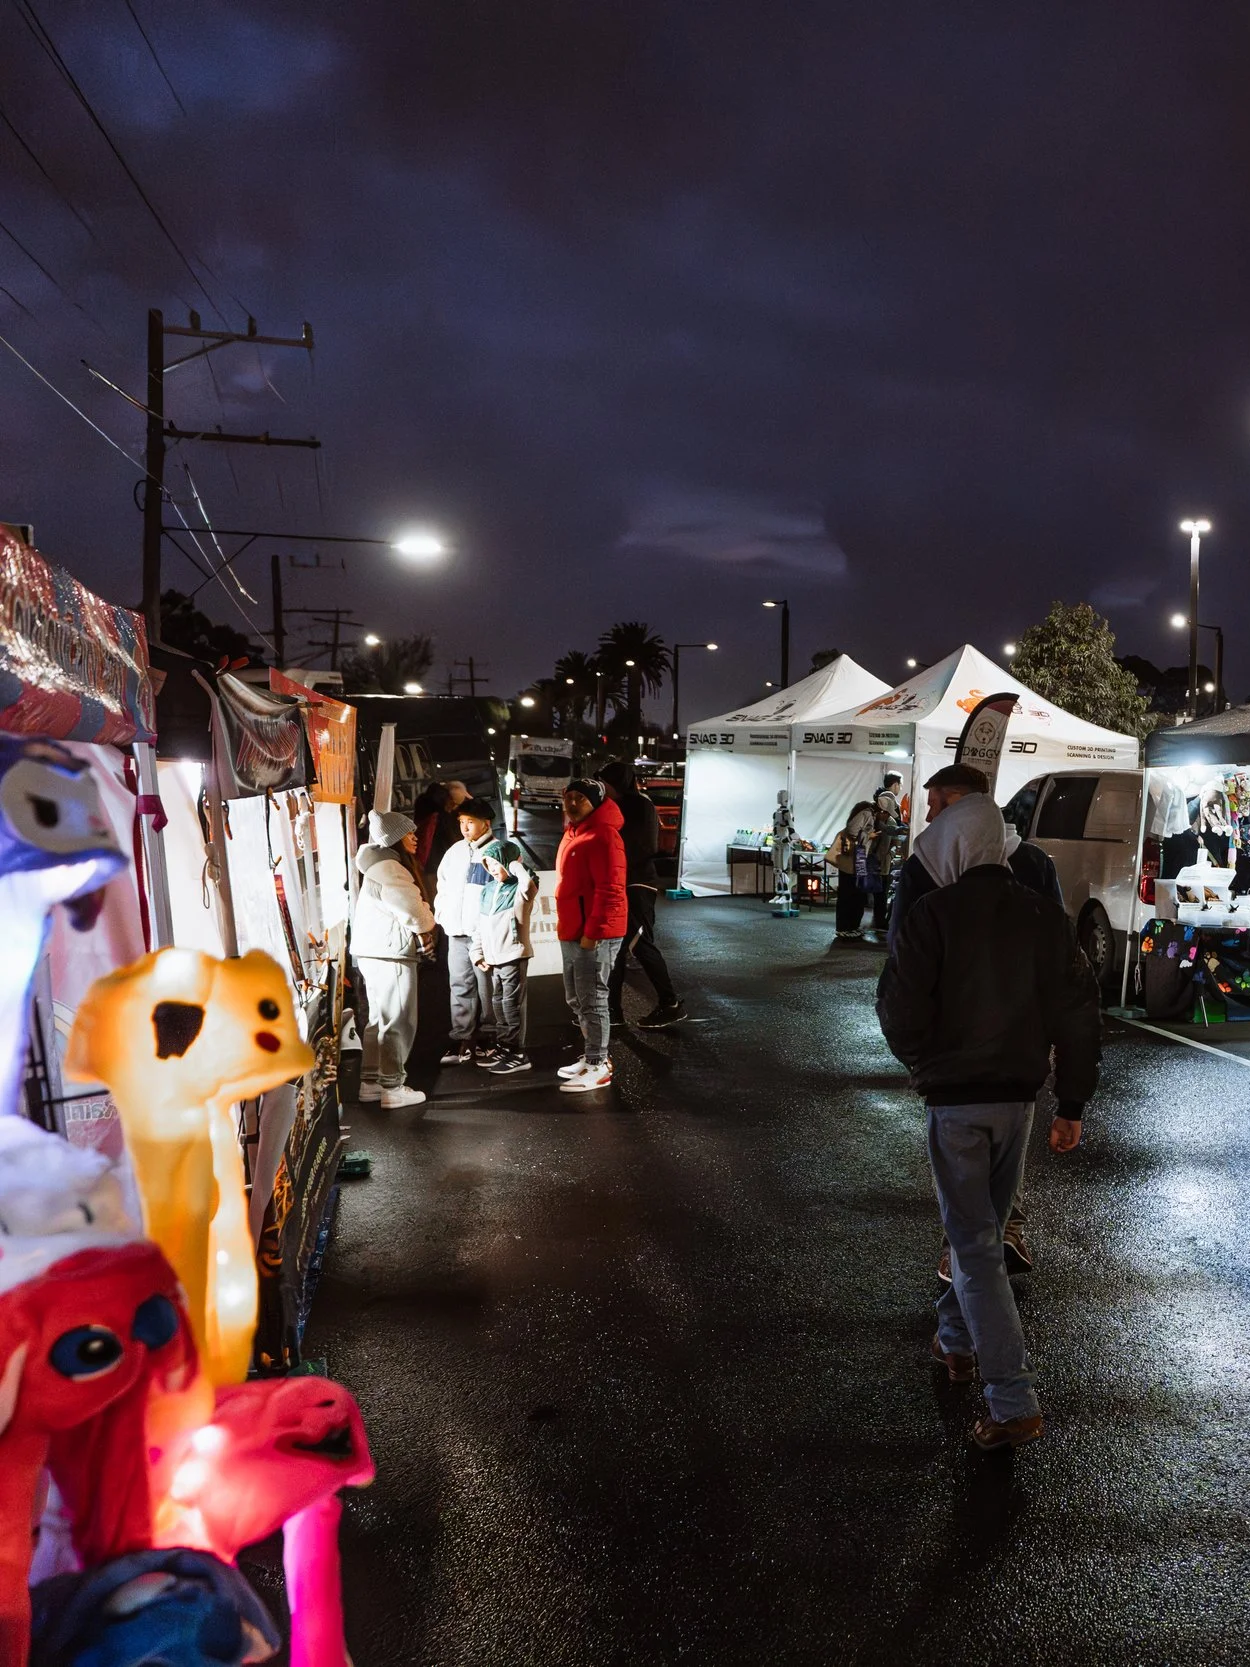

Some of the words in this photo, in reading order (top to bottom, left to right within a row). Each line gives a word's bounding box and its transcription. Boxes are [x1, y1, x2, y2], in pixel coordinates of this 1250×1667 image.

[689, 733, 718, 745] SNAG
[719, 733, 735, 745] 3D
[802, 732, 835, 745] SNAG
[836, 732, 853, 745] 3D
[1008, 740, 1038, 754] 3D
